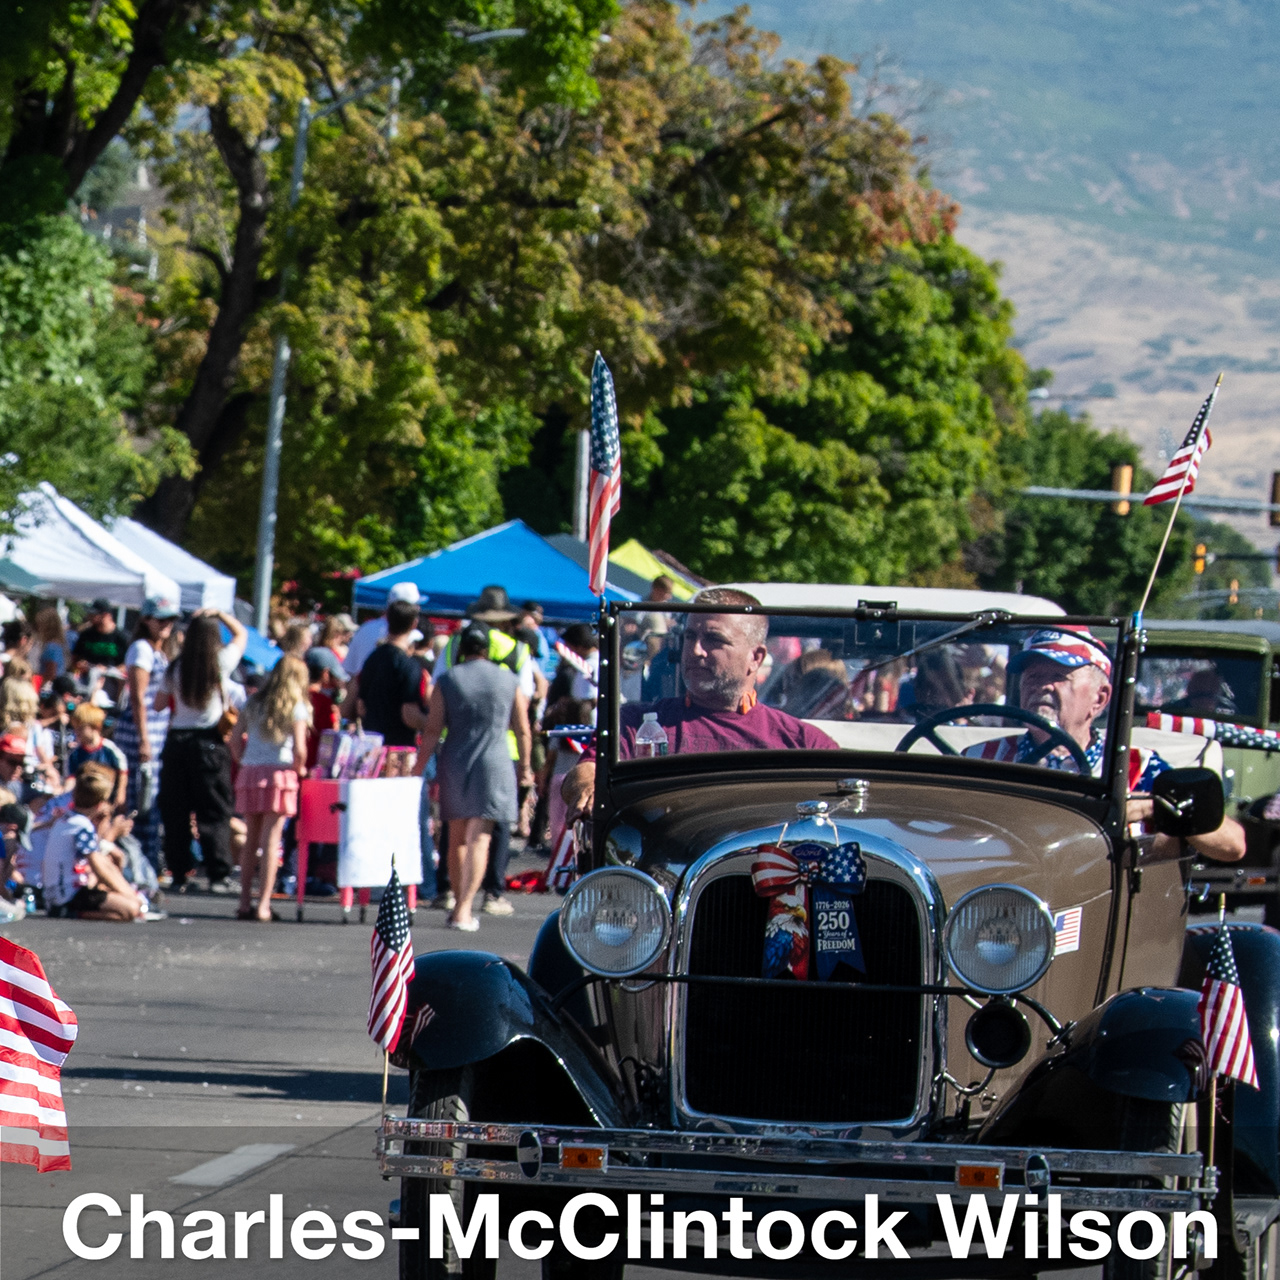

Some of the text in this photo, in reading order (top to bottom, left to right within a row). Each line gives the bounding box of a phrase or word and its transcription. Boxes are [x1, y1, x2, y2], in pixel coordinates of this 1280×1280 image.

[817, 911, 850, 931] 250
[822, 930, 841, 939] Years
[817, 938, 856, 952] FREEDOM
